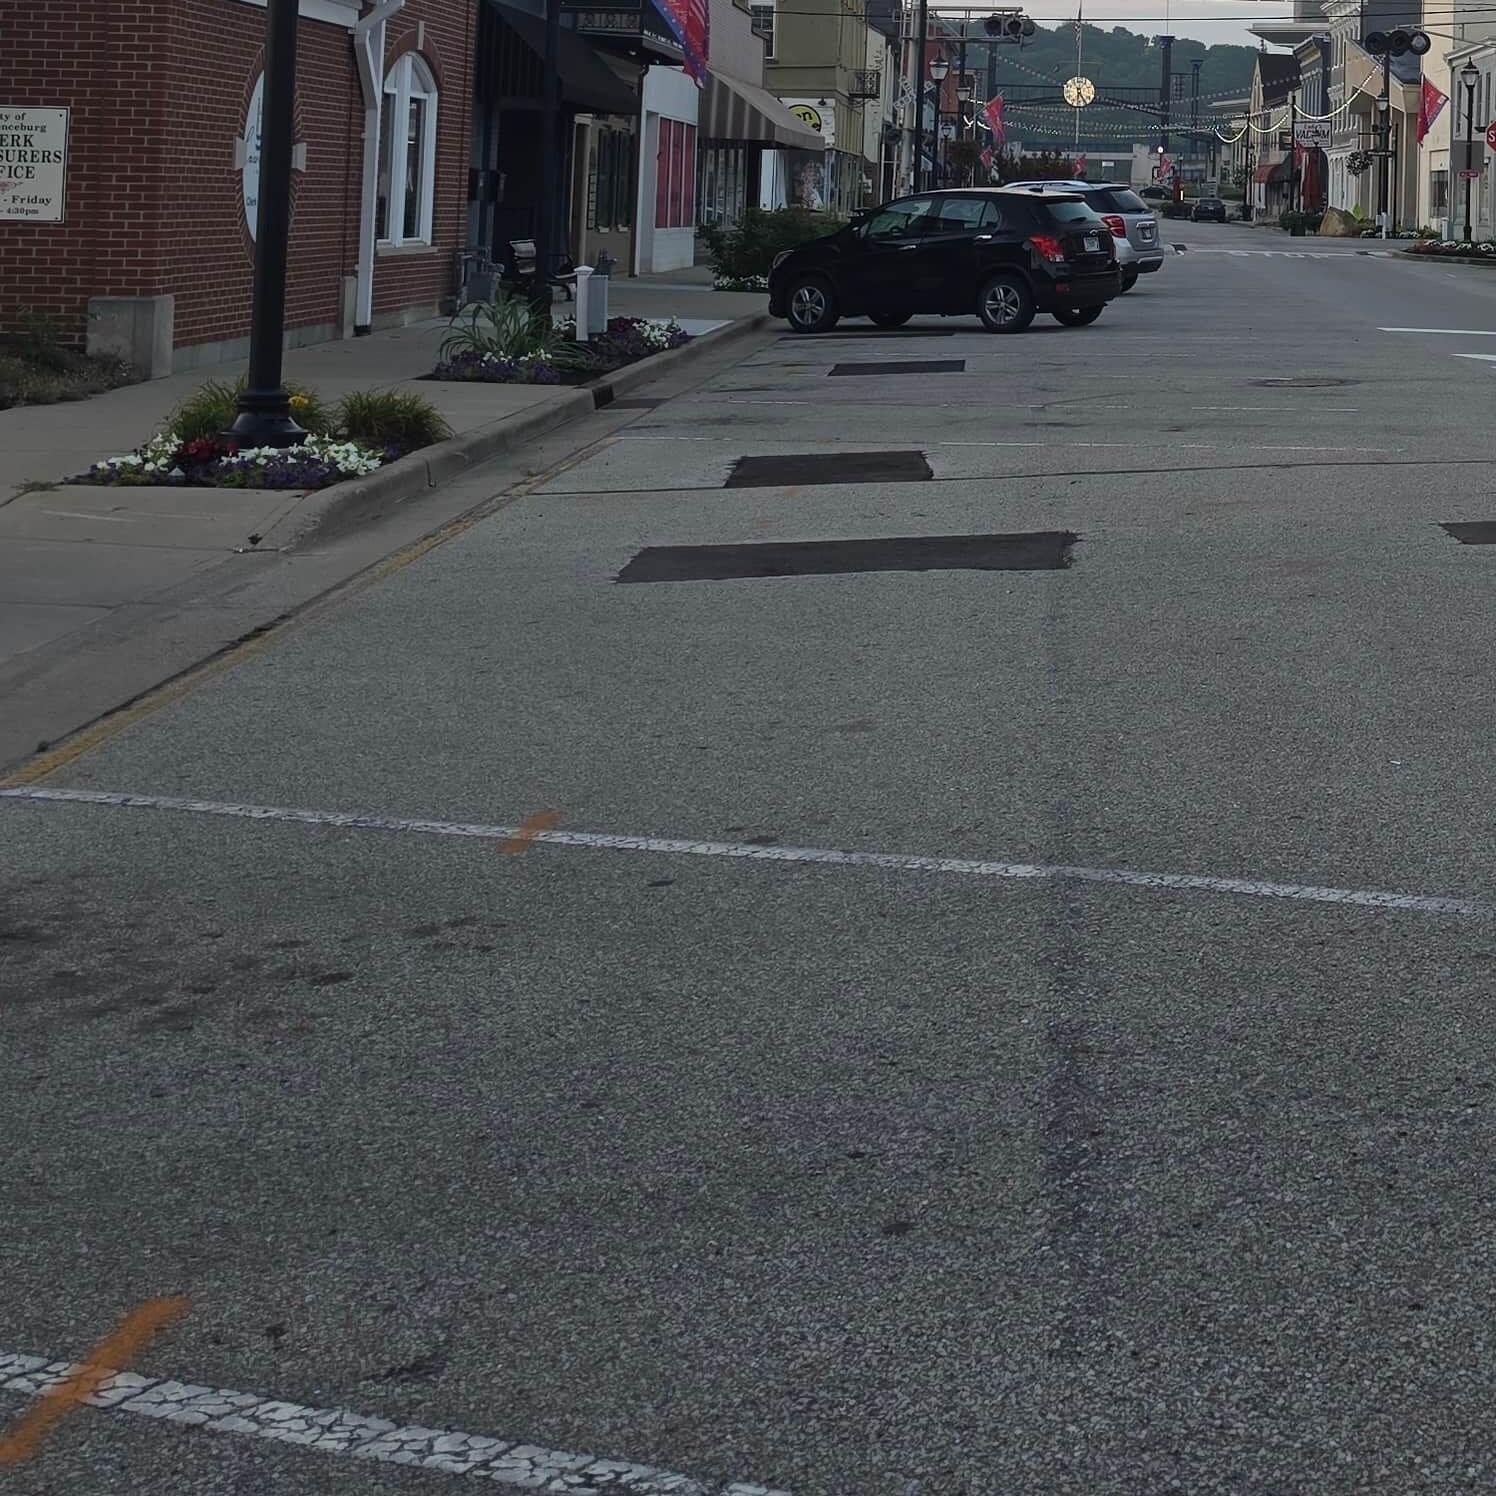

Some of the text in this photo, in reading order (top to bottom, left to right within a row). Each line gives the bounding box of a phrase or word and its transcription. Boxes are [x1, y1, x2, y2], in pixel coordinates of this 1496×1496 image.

[15, 112, 26, 121] of
[11, 195, 52, 206] Friday
[7, 207, 39, 216] 4:30pm
